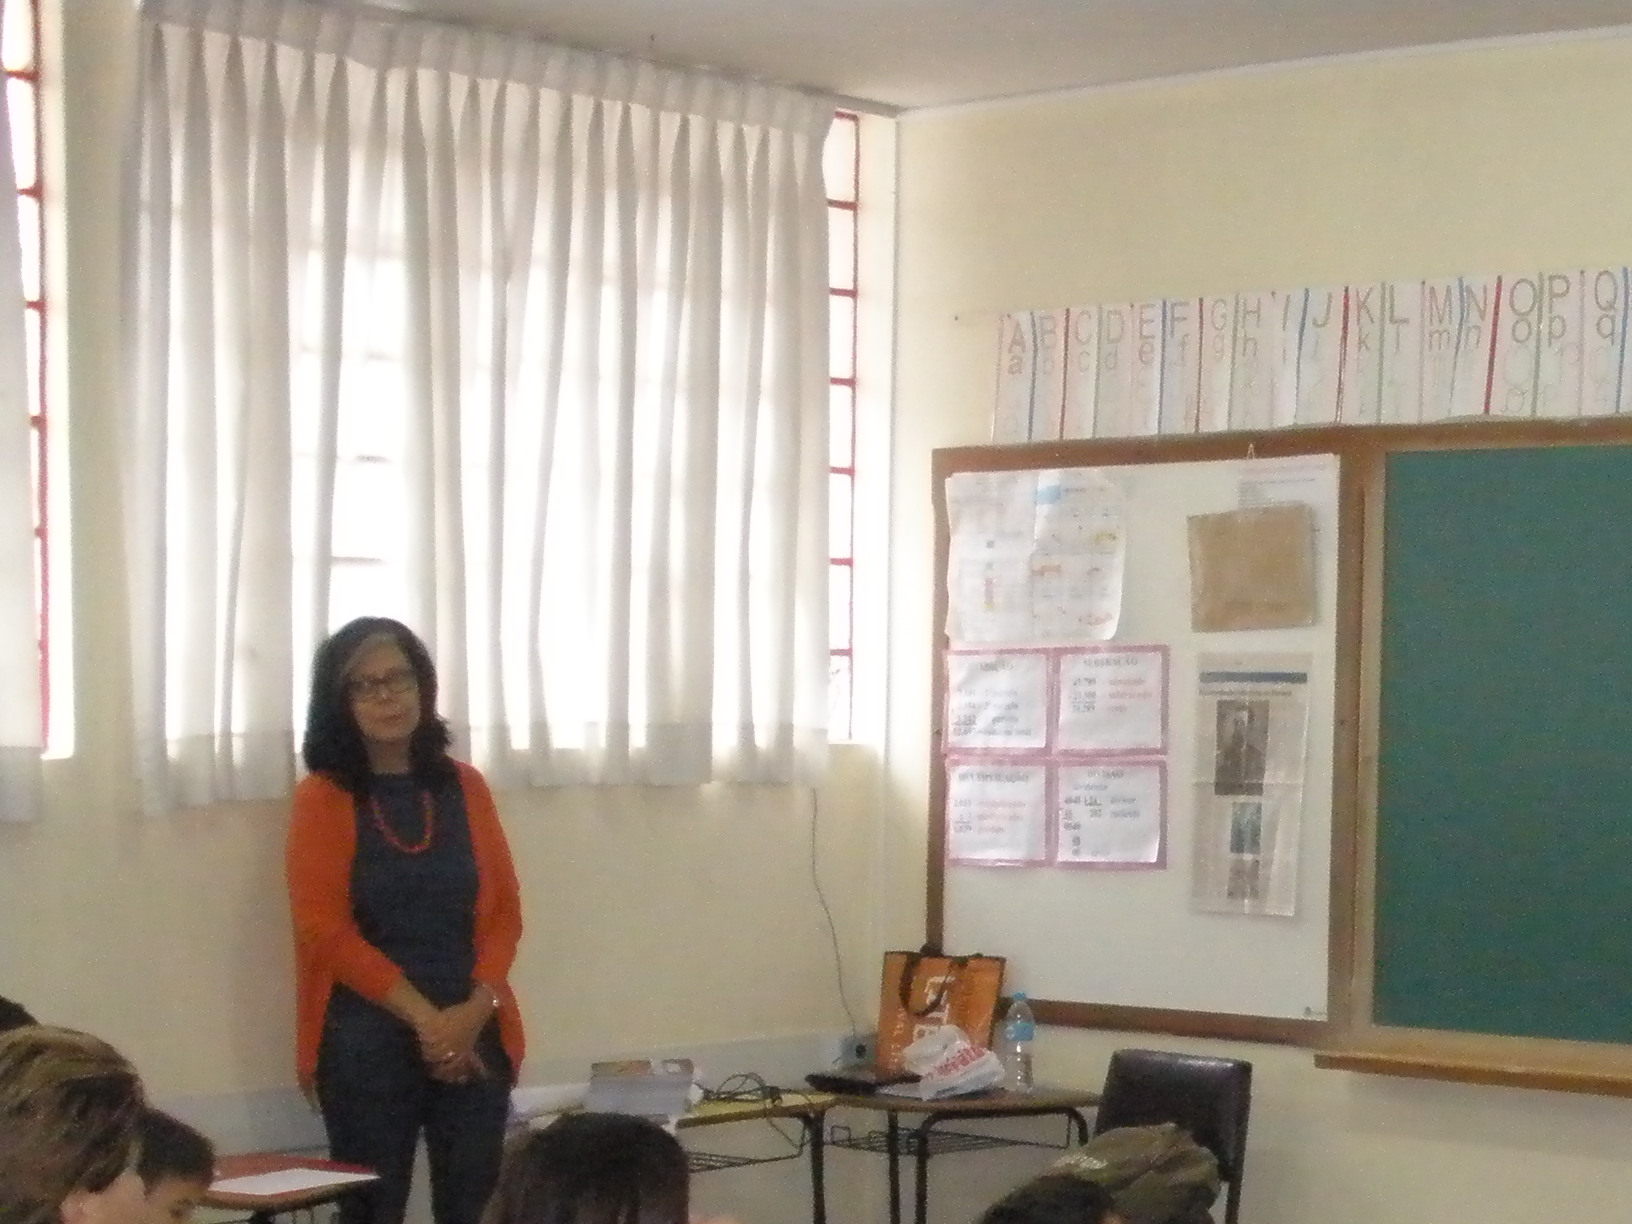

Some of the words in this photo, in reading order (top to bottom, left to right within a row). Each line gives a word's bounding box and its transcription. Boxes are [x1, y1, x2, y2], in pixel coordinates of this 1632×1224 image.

[1008, 319, 1026, 353] A
[1075, 310, 1092, 345] C
[1106, 310, 1124, 343] D
[1139, 304, 1155, 339] E
[1170, 302, 1189, 338] F
[1211, 299, 1227, 331] G
[1241, 298, 1261, 329] H
[1312, 292, 1333, 328] J
[1356, 287, 1374, 325] K
[1389, 285, 1409, 323] L
[1429, 285, 1452, 326] M
[1465, 285, 1487, 323] N
[1509, 278, 1538, 316] O
[1548, 274, 1571, 314] P
[1594, 270, 1618, 312] Q
